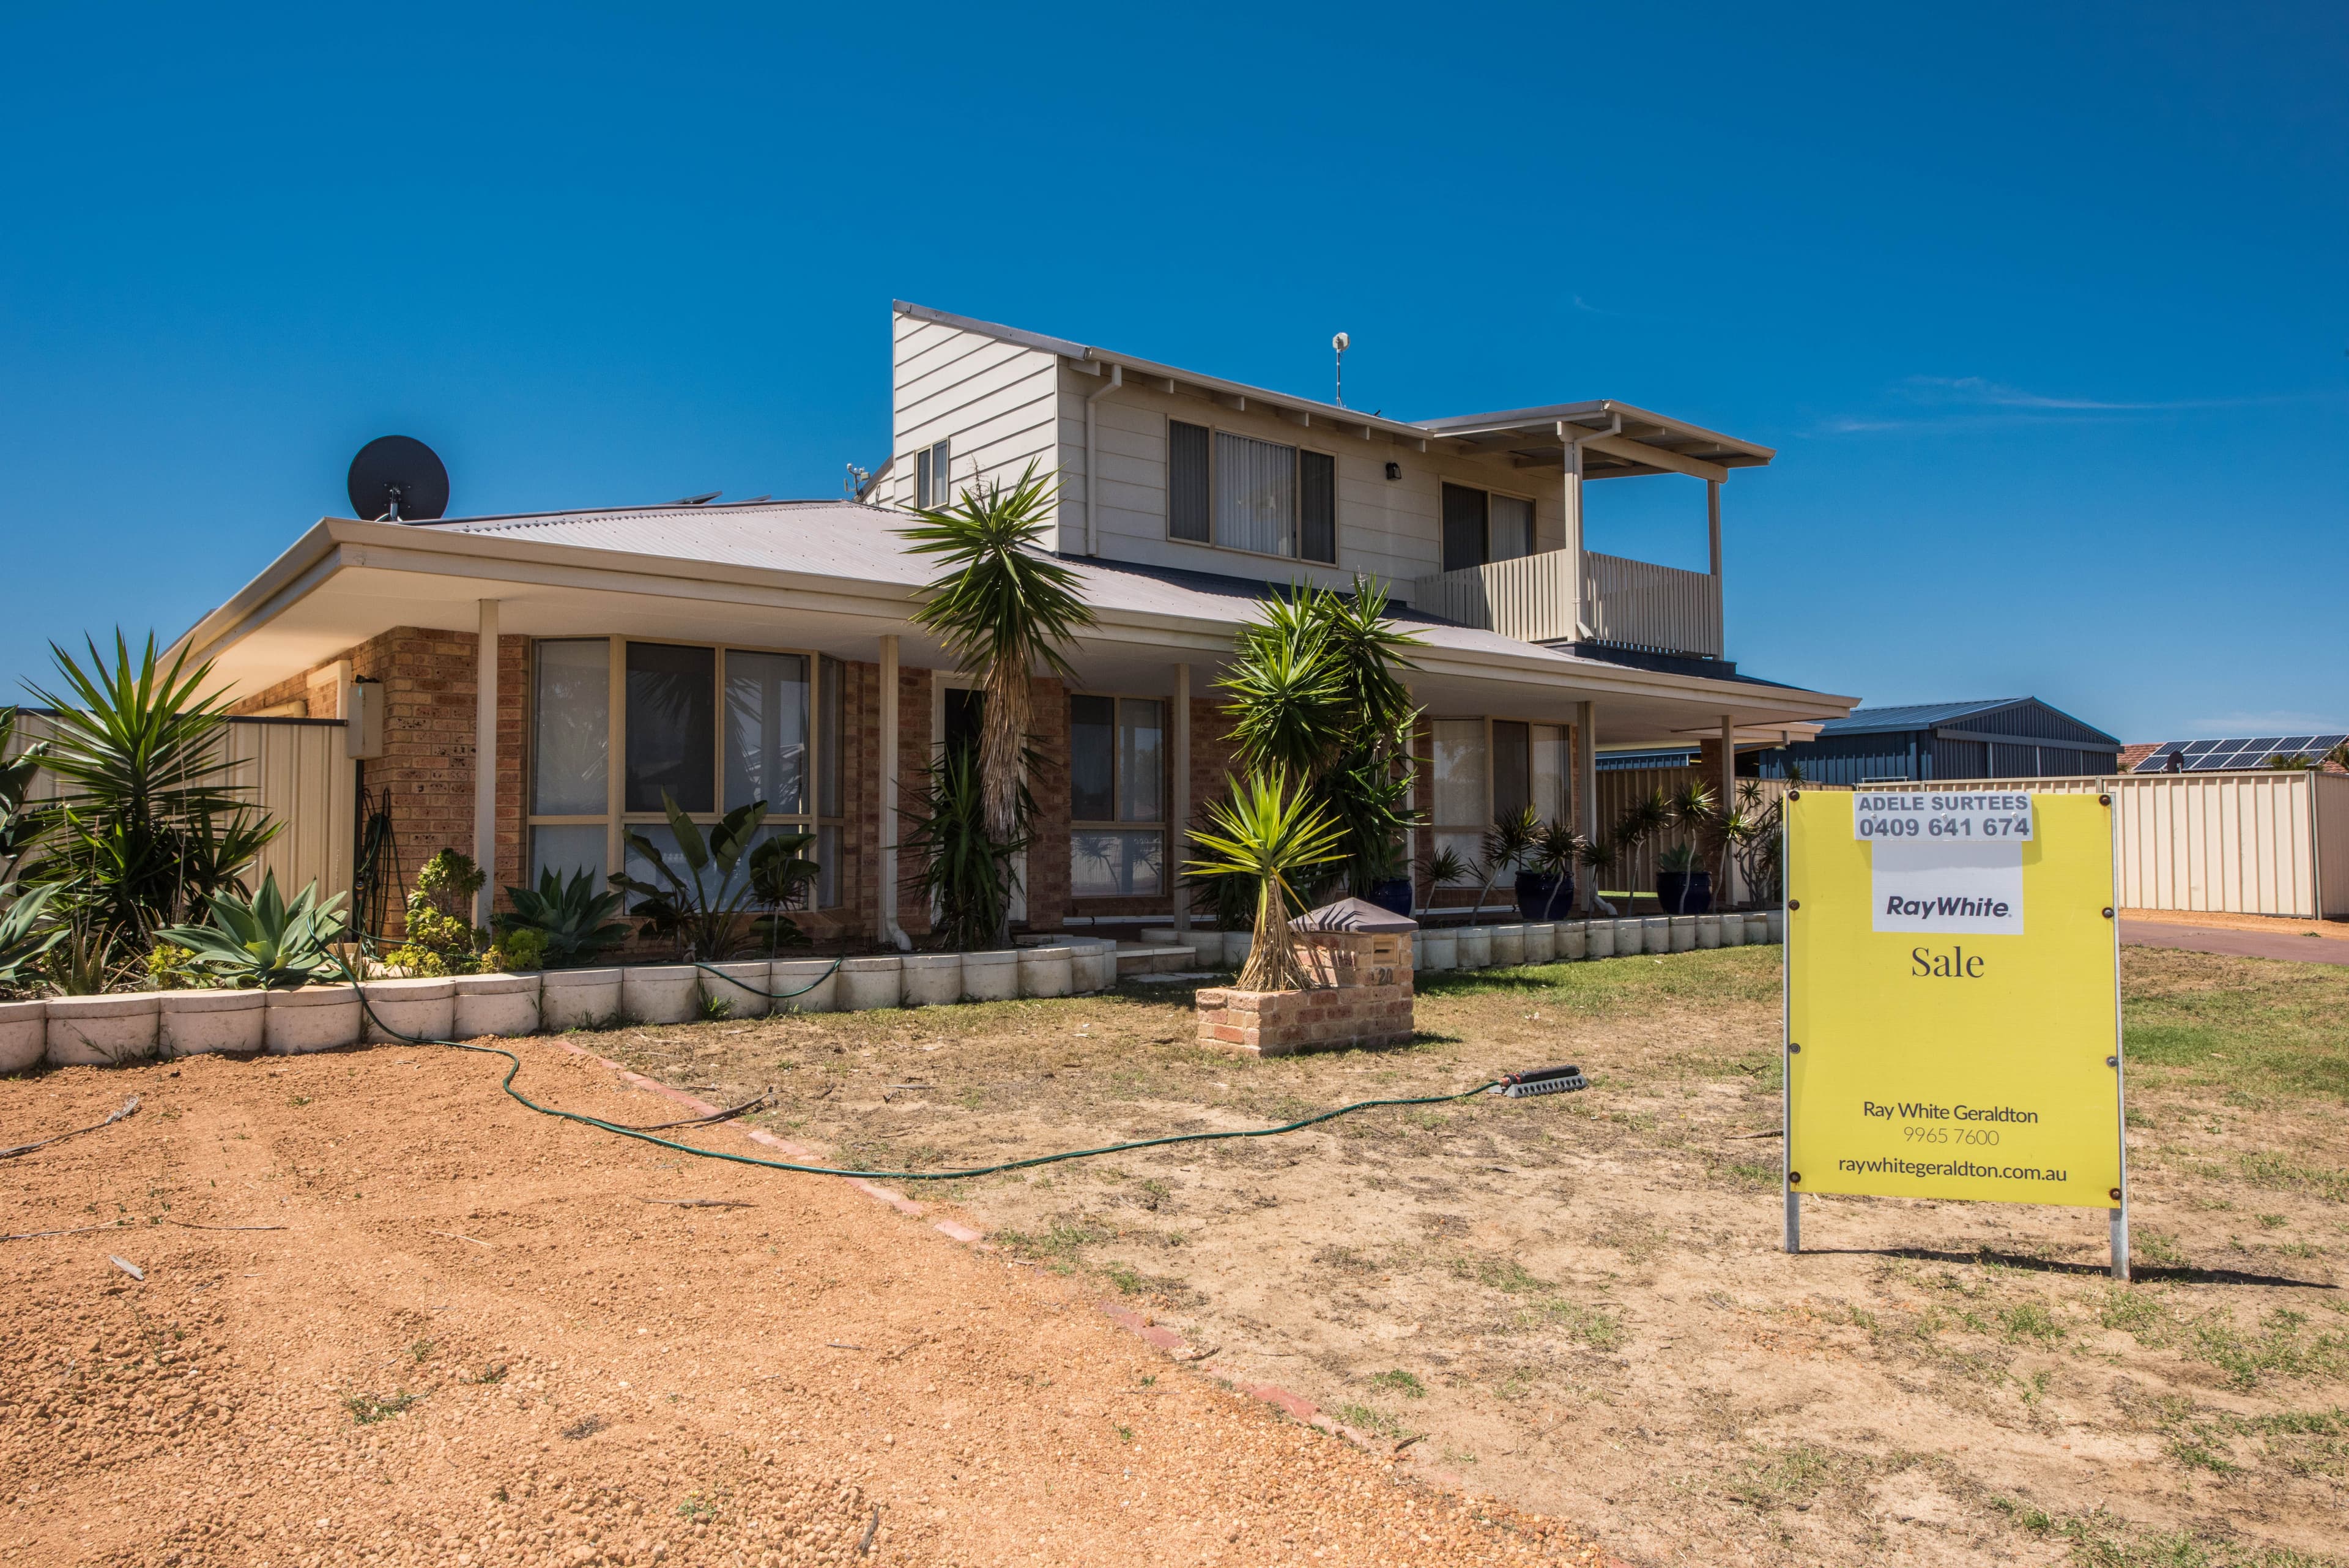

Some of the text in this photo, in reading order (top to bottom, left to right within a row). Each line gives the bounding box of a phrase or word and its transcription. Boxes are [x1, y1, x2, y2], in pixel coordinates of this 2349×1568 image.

[1859, 796, 2028, 811] ADELE SURTEES
[1860, 818, 2030, 837] 0409 641 674
[1887, 896, 2009, 920] RayWhite
[1912, 946, 1984, 978] Sale
[1378, 968, 1393, 985] 20
[1863, 1101, 2038, 1124] Ray White Geraldton
[1904, 1126, 2000, 1146] 9965 7600
[1839, 1157, 2067, 1181] raywhitegeraldton.com.au
